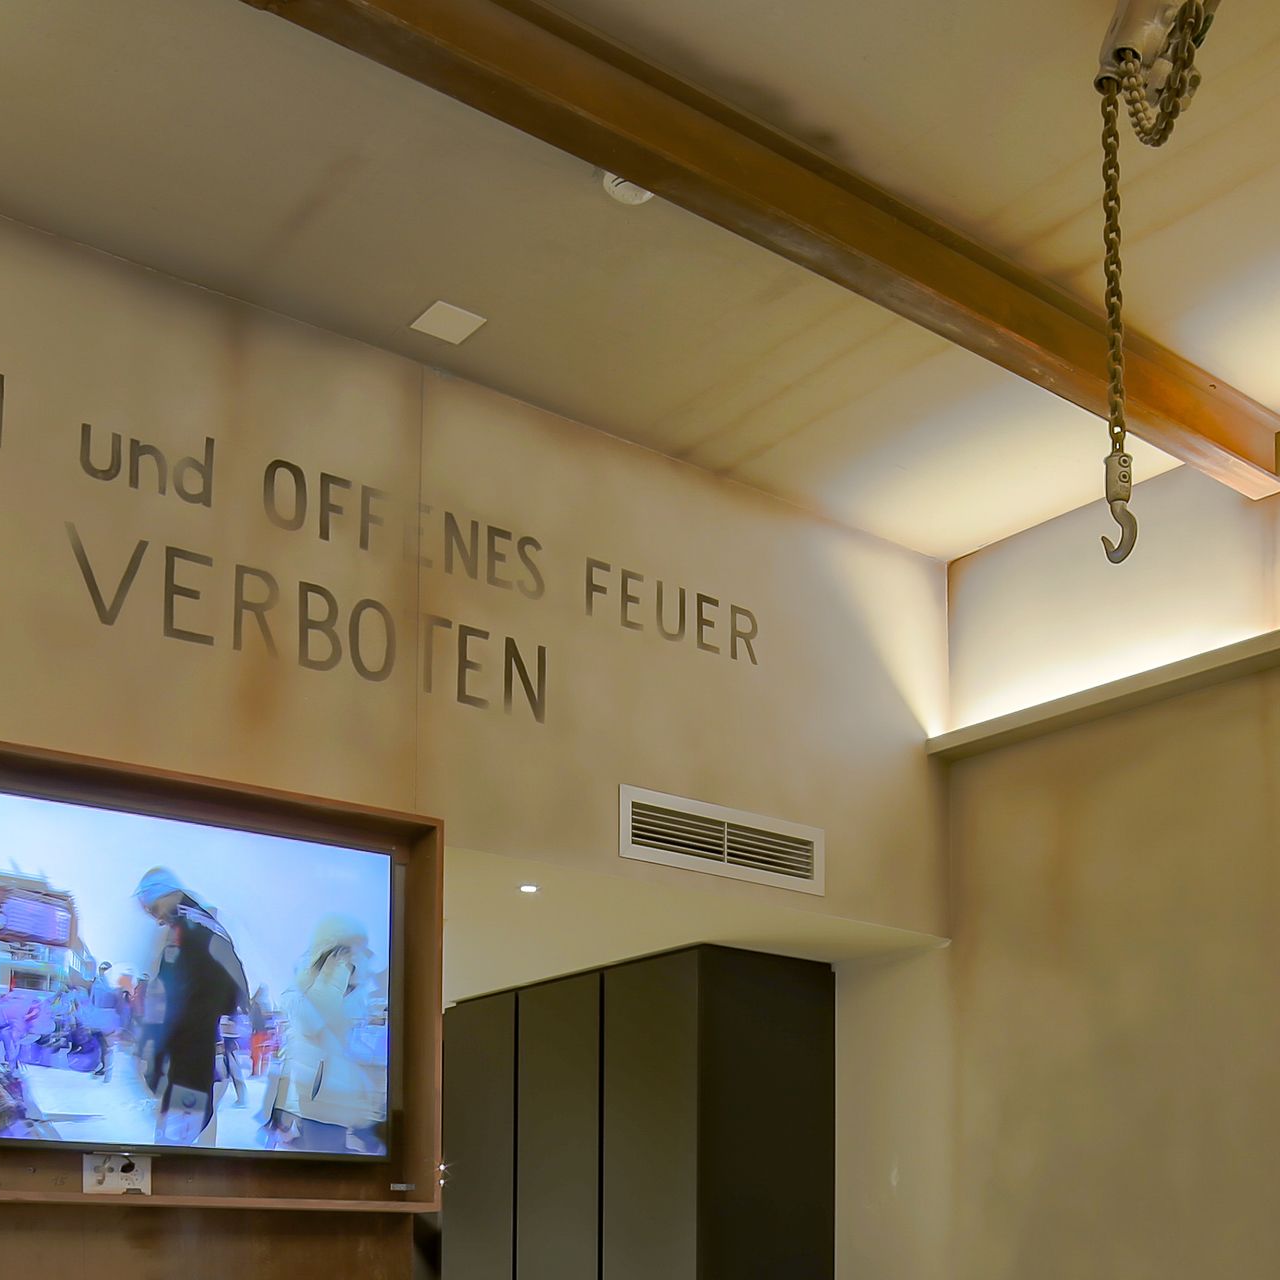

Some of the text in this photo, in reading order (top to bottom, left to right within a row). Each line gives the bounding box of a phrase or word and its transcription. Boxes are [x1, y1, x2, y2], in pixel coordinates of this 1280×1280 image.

[63, 520, 548, 725] VERBOTEN
[78, 422, 216, 508] und
[262, 458, 547, 601] OFFENES
[584, 555, 760, 667] FEUER
